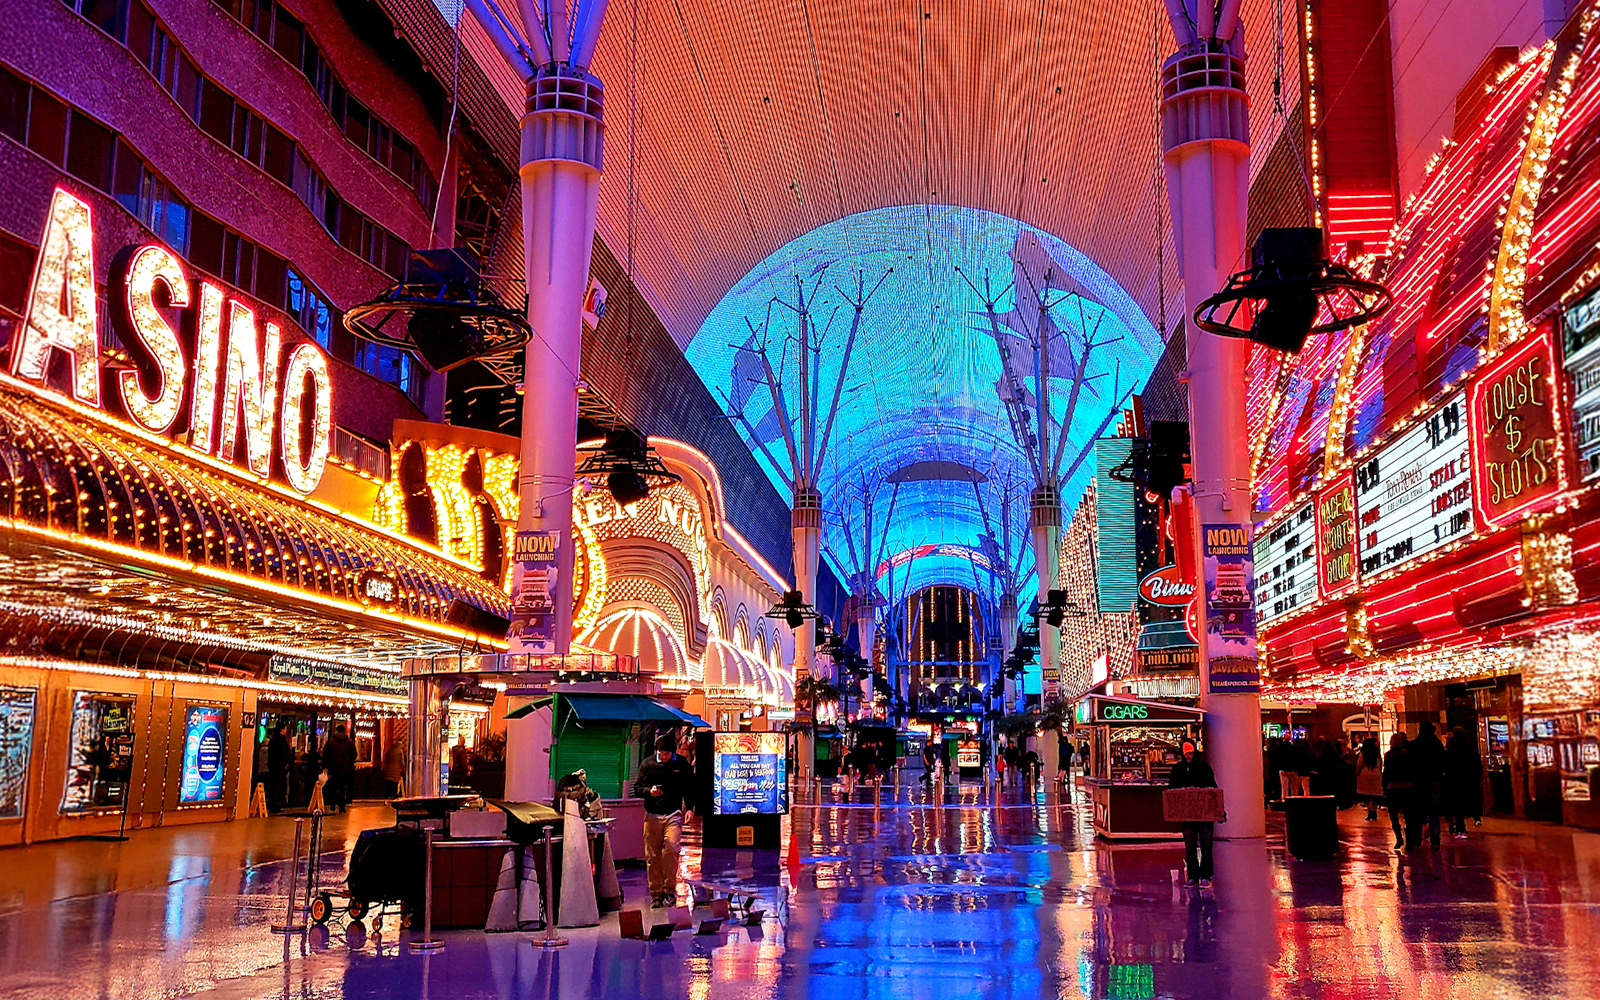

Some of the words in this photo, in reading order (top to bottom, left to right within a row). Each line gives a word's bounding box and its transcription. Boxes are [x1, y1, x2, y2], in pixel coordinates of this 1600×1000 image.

[1485, 357, 1543, 434] LOOSE
[1504, 414, 1522, 453] $
[1429, 459, 1456, 491] STEAK
[1489, 438, 1547, 505] SLOTS
[1320, 493, 1343, 526] RACE
[1431, 480, 1470, 518] LOBSTER
[516, 536, 556, 553] NOW
[1207, 528, 1249, 546] NOW
[1208, 546, 1249, 555] LAUNCHING
[1322, 519, 1353, 556] SPORTS
[515, 553, 555, 562] LAUNCHING
[244, 714, 254, 725] 02
[1103, 705, 1148, 719] CIGARS
